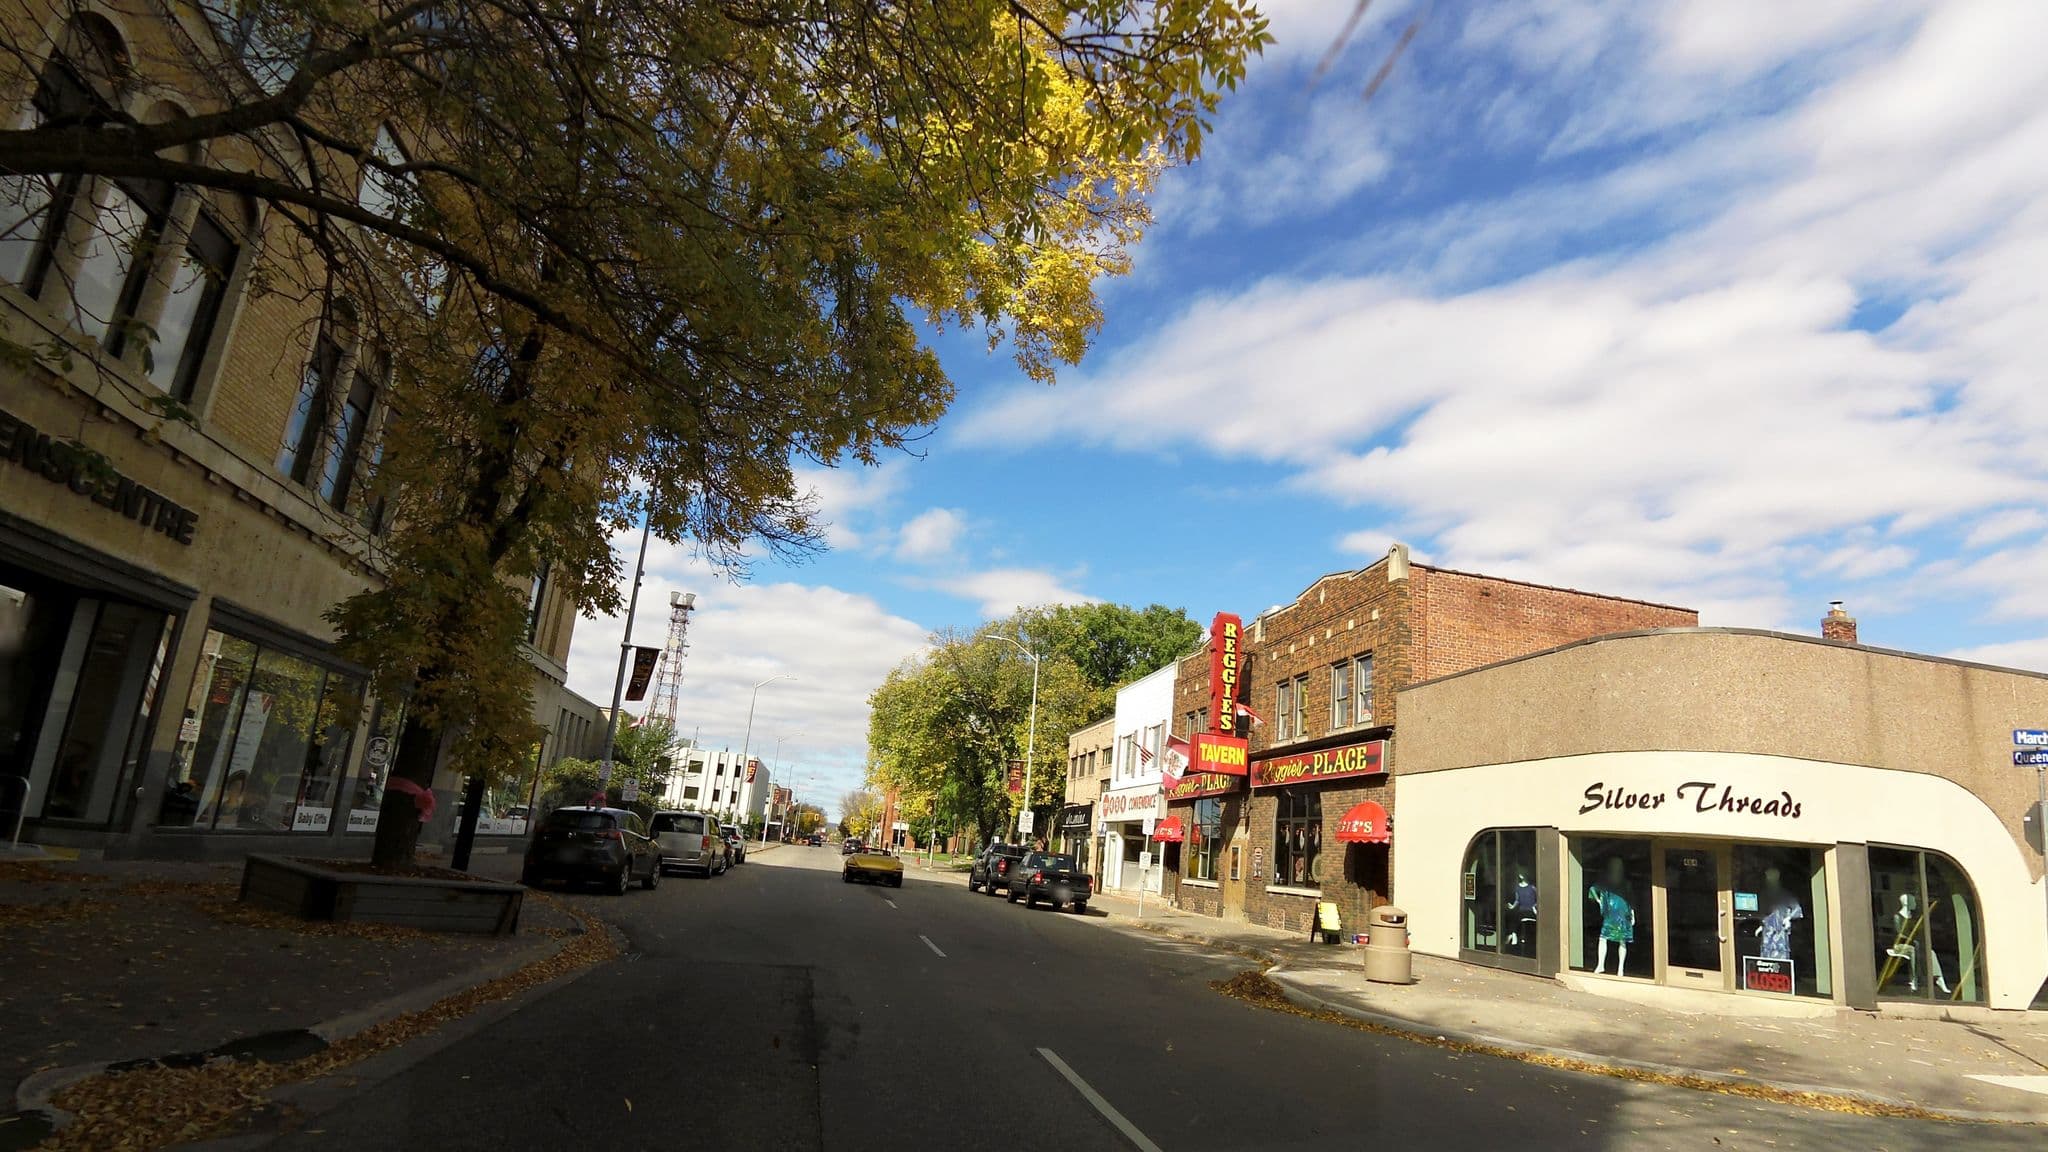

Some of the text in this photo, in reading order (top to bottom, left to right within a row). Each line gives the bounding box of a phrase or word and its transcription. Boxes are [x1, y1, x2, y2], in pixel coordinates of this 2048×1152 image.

[1220, 622, 1238, 731] REGGIES
[1200, 743, 1246, 767] TAVERN
[1312, 745, 1367, 776] PLACE
[1578, 781, 1801, 818] Silver Threads
[1747, 971, 1791, 992] CLOSED
